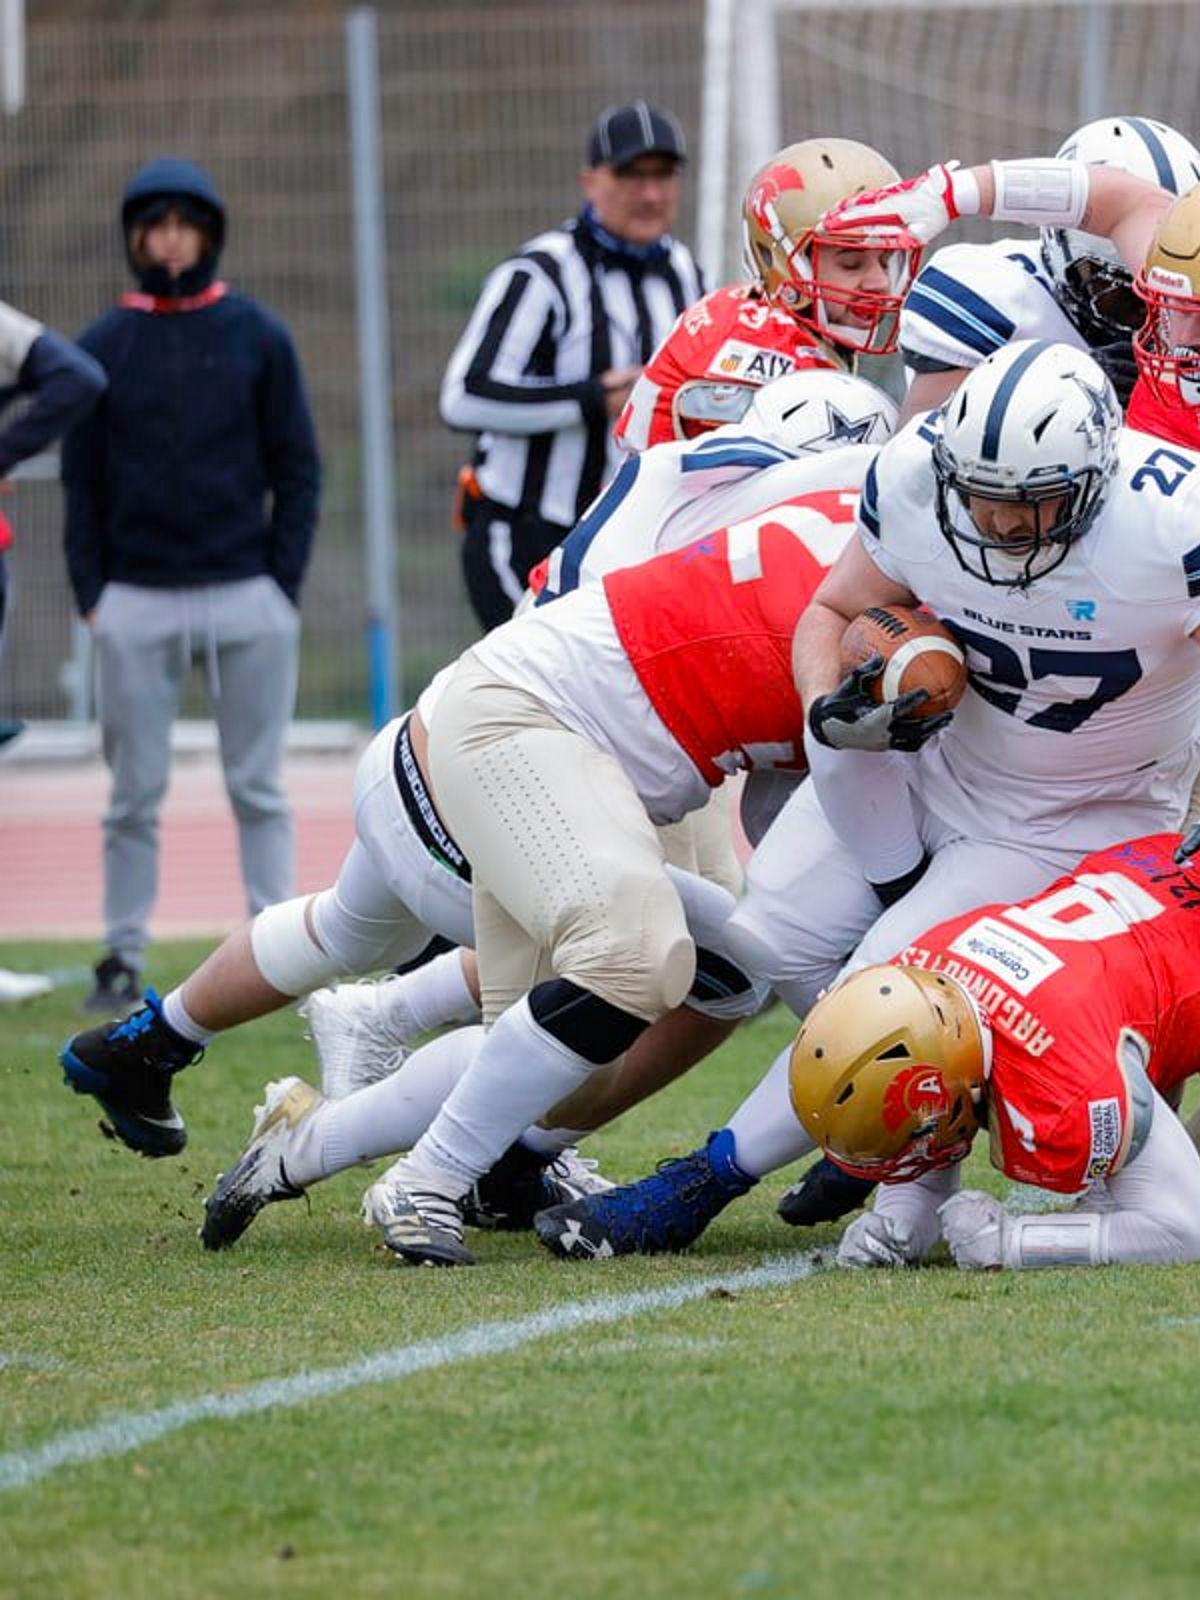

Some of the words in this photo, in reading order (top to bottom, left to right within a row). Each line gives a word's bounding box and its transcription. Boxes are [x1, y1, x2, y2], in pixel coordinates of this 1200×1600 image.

[1130, 448, 1196, 496] 27
[962, 608, 1014, 633] BLUE
[1019, 625, 1092, 641] STARS
[943, 618, 1143, 733] 27
